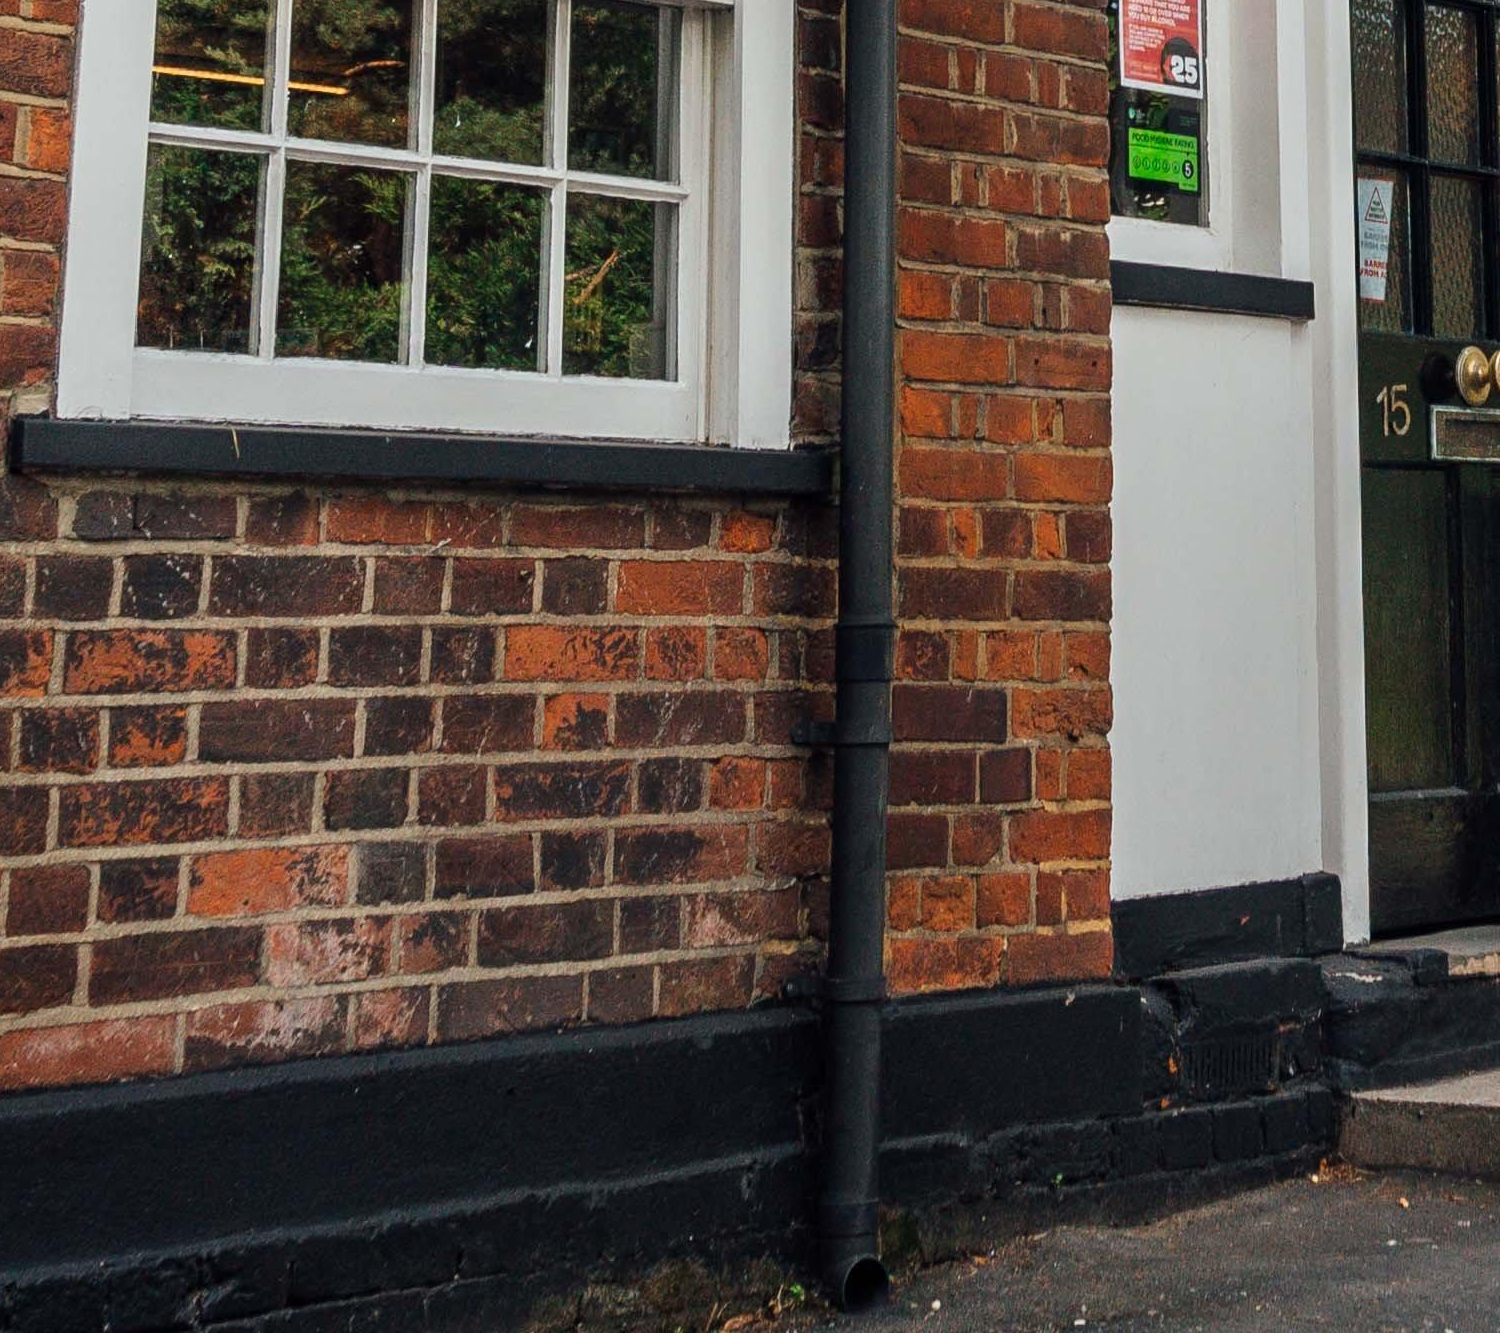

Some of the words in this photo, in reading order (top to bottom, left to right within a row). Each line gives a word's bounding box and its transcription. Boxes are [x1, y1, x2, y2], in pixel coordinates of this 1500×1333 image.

[1171, 55, 1198, 84] 25
[1184, 162, 1192, 178] 5
[1376, 384, 1411, 437] 15
